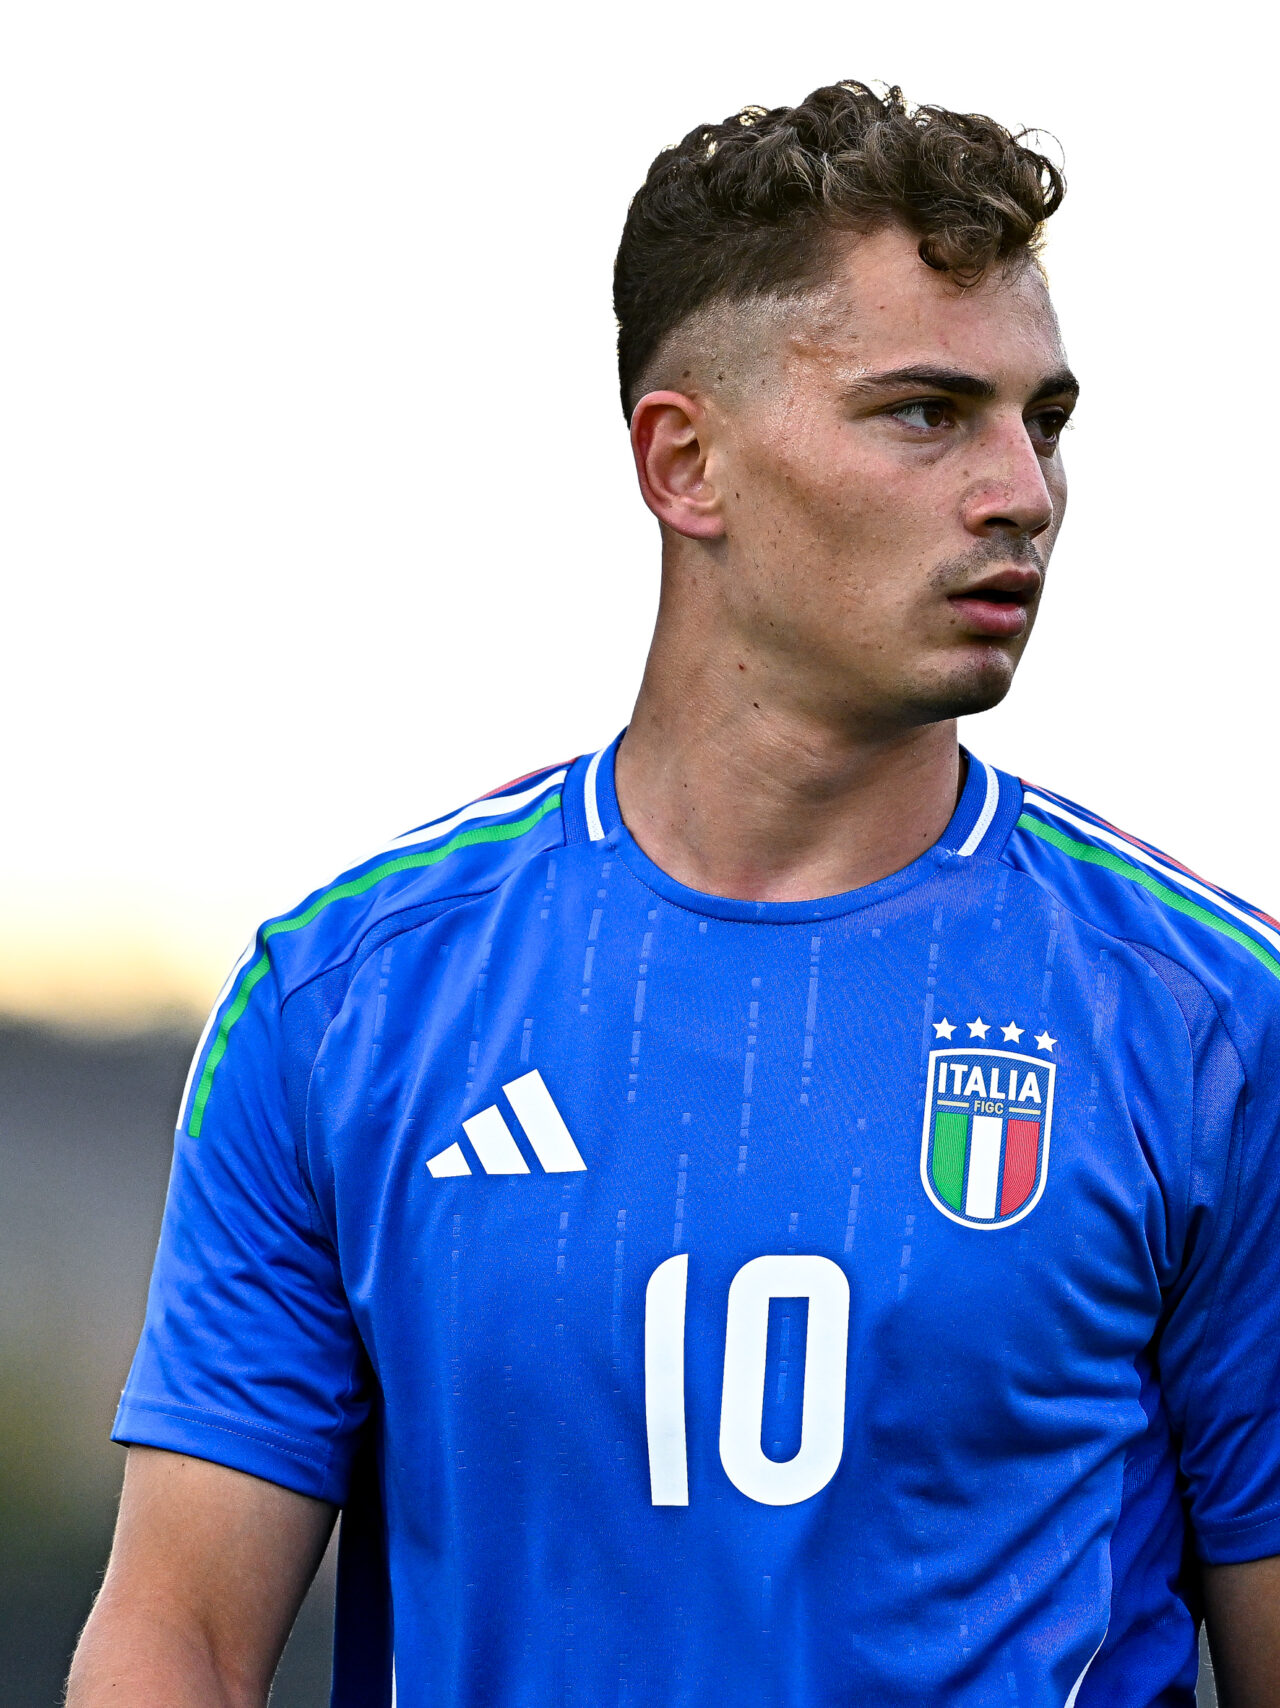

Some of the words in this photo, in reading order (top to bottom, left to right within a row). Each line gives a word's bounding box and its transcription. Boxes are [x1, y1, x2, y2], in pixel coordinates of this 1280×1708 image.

[938, 1062, 1042, 1103] ITALIA
[973, 1100, 1004, 1114] FIGC
[644, 1253, 850, 1506] 10
